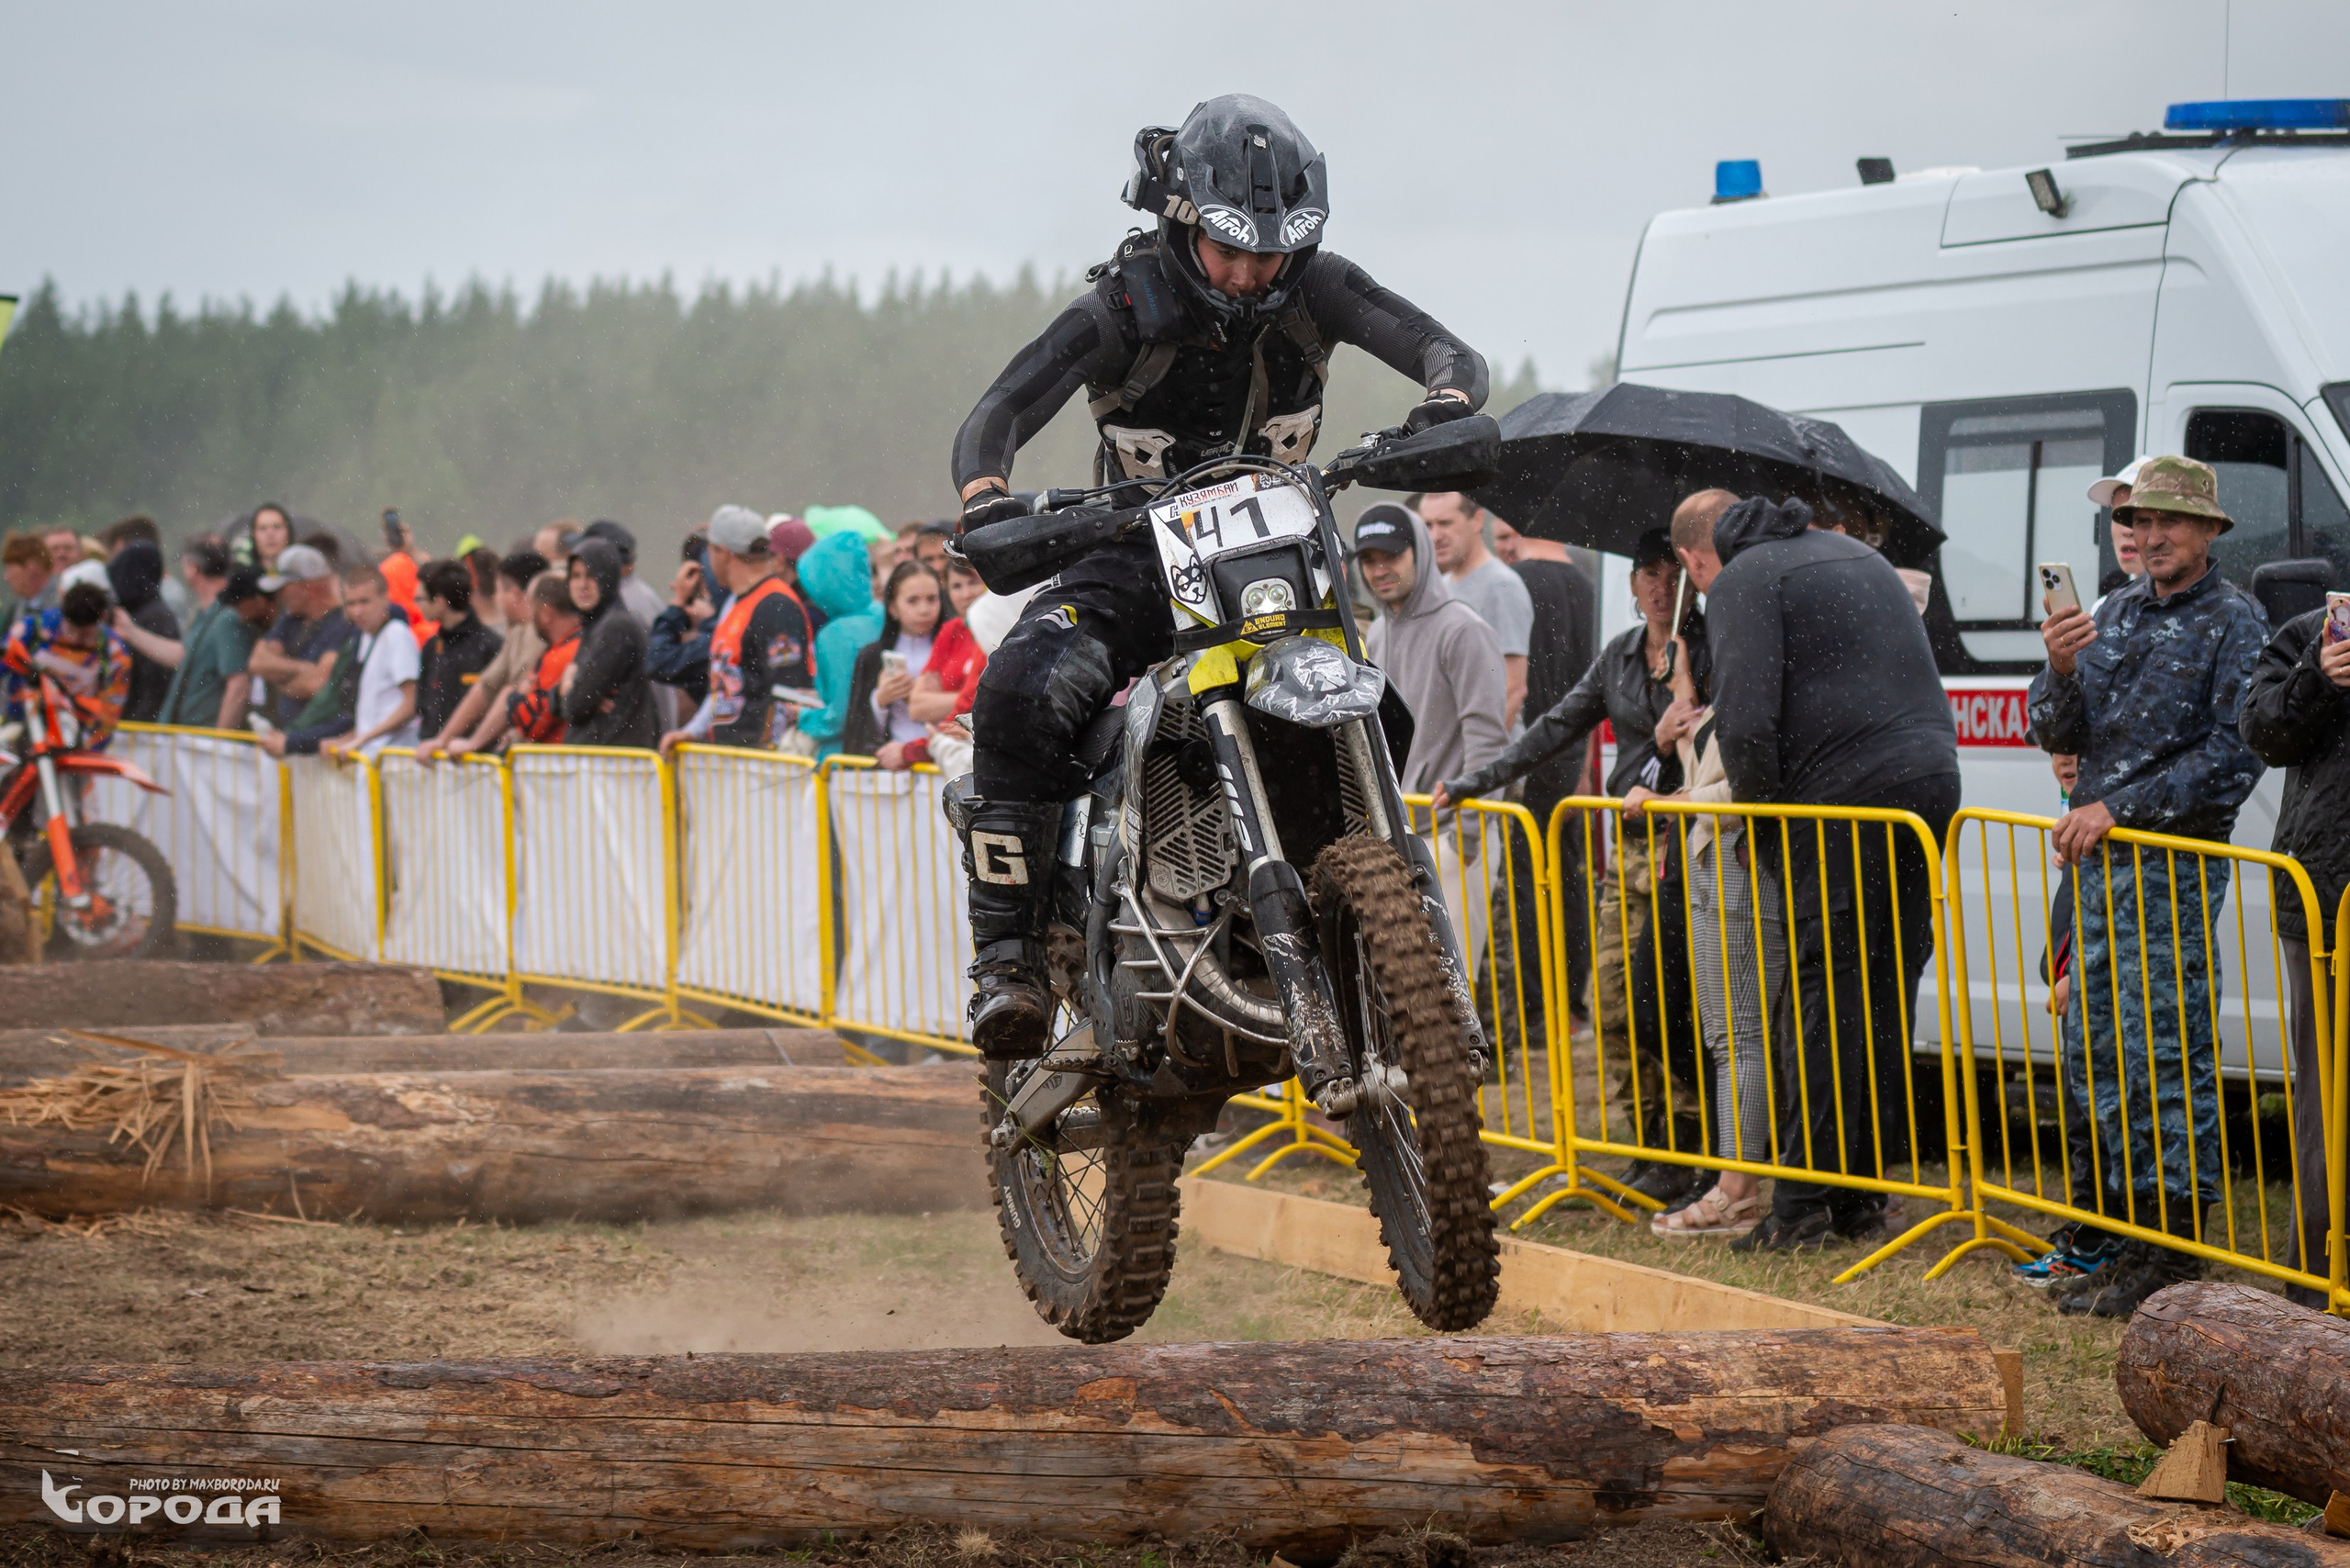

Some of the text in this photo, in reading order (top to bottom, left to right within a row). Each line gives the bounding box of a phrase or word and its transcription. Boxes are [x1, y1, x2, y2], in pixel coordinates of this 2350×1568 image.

[1163, 193, 1203, 228] 10
[1203, 209, 1250, 244] Airoh
[1285, 212, 1322, 244] Airoh
[1192, 496, 1270, 548] 41
[1254, 613, 1285, 625] ENDURO
[1951, 695, 2029, 740] НСКА
[970, 830, 1029, 885] G
[1003, 1185, 1021, 1228] GUMMY
